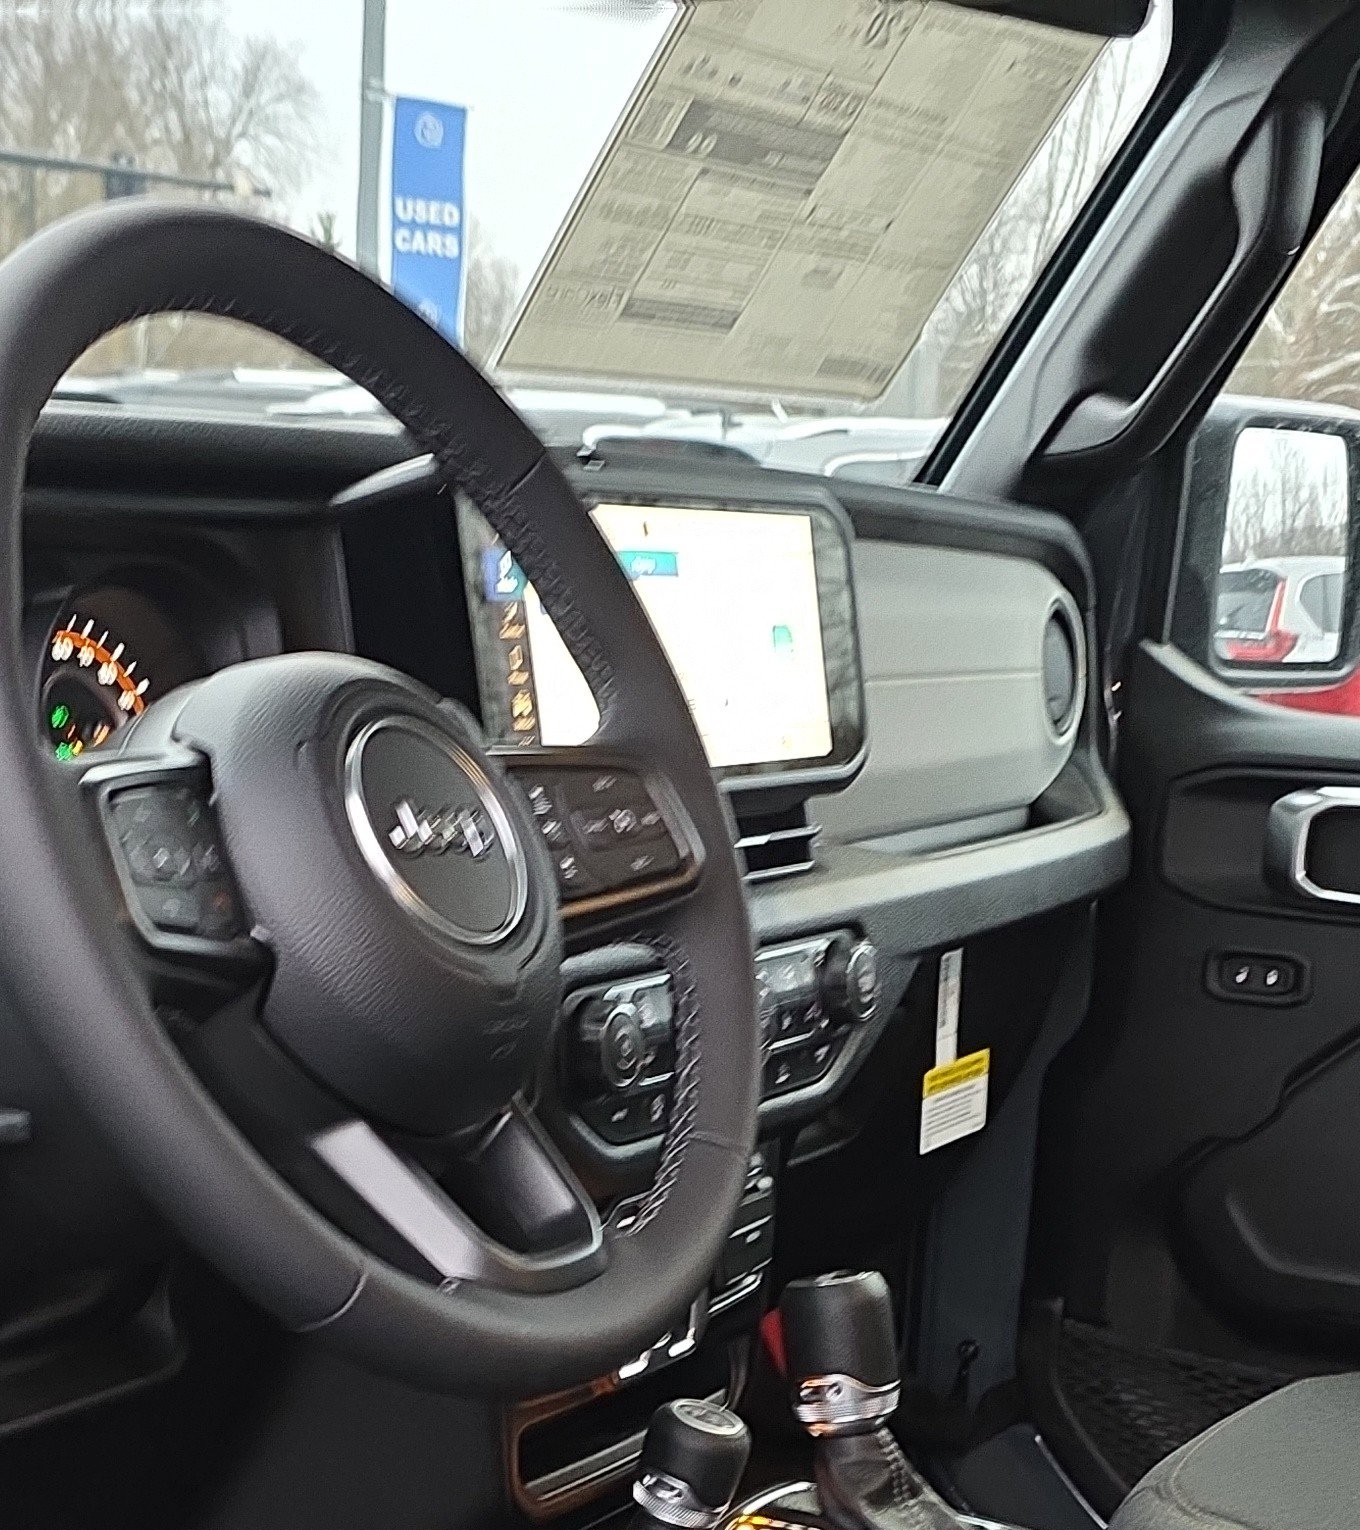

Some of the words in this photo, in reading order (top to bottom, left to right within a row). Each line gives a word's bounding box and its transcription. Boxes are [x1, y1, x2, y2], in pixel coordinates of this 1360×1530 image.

[394, 196, 460, 228] USED
[394, 227, 459, 259] CARS
[387, 799, 496, 861] Jeep
